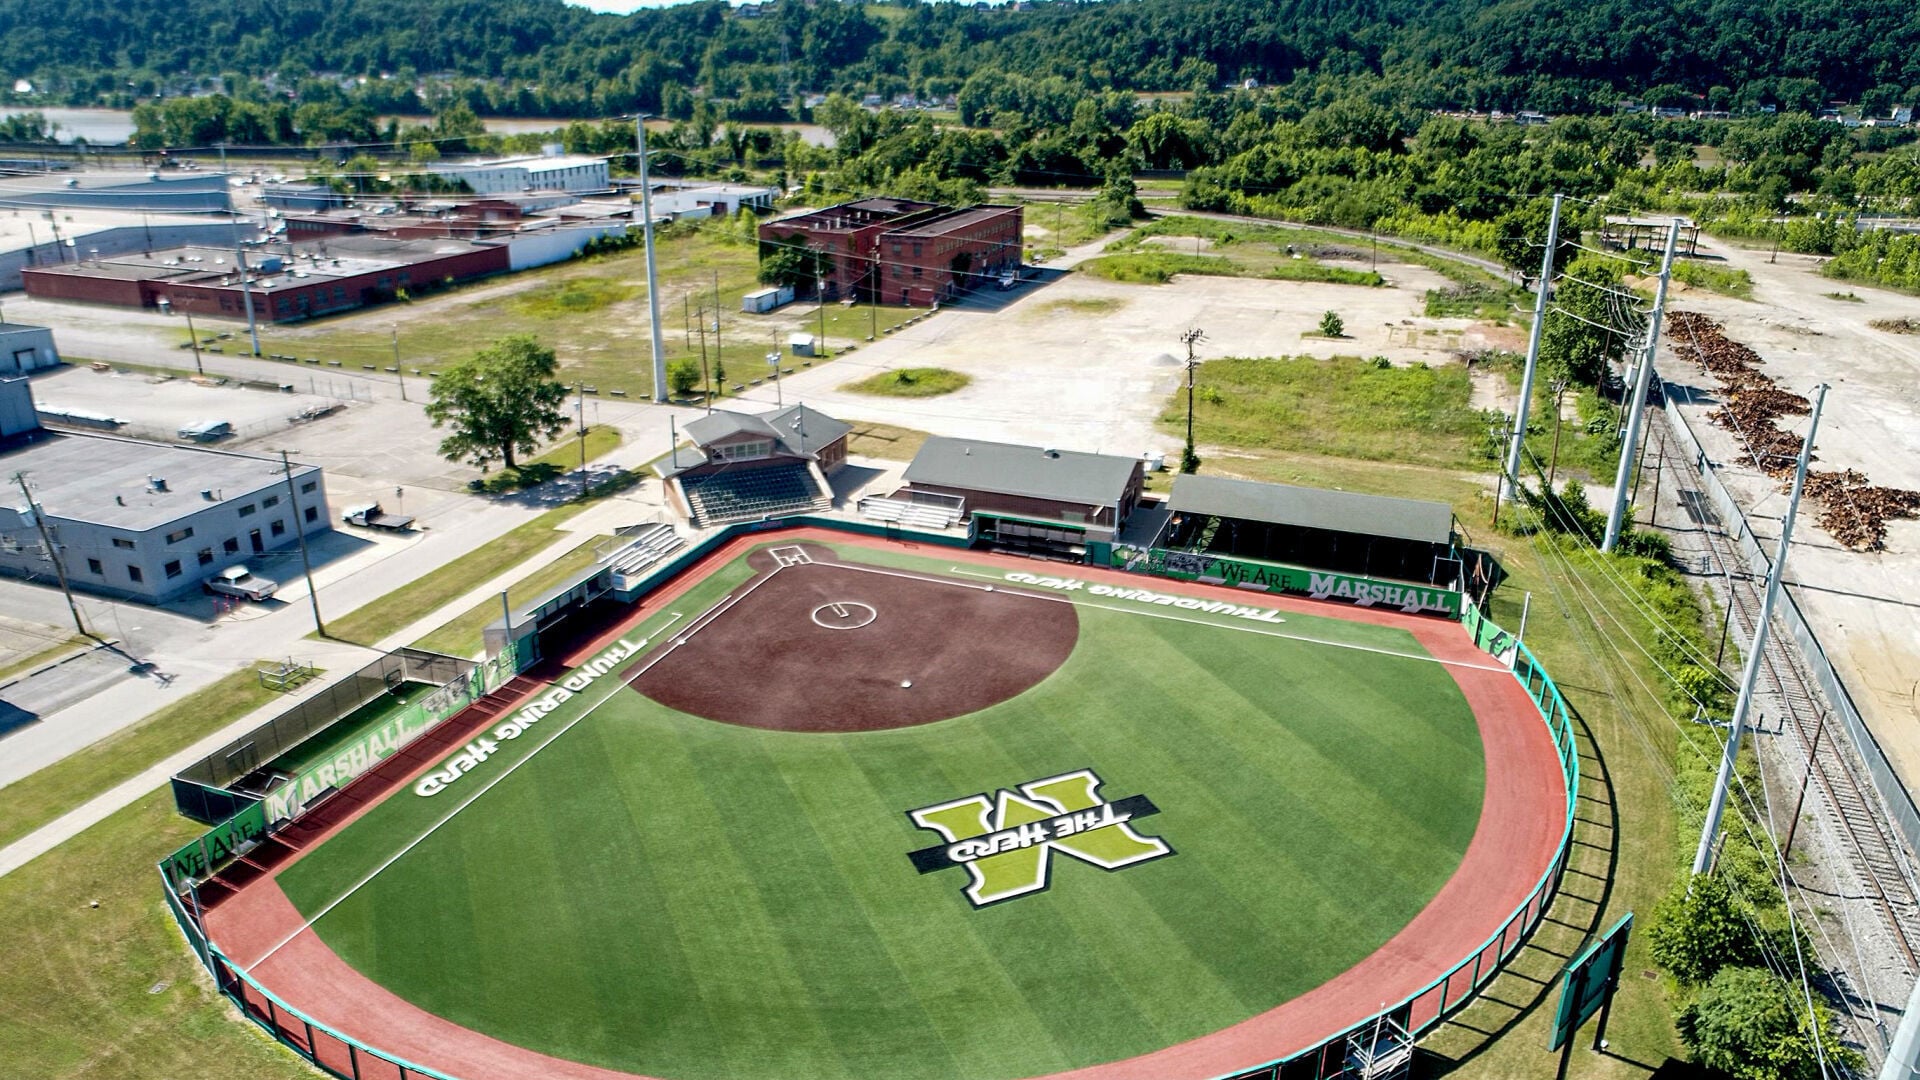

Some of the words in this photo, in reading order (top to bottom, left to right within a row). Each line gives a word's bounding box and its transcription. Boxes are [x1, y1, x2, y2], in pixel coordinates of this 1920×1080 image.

[1003, 573, 1084, 591] HERD
[1308, 573, 1451, 613] MARSHALL
[1088, 586, 1286, 623] THUNDERING
[497, 639, 648, 740] THUNDERING
[265, 717, 414, 824] MARSHALL
[415, 738, 498, 797] HERD
[1053, 803, 1132, 832] THE
[949, 825, 1050, 862] HERD
